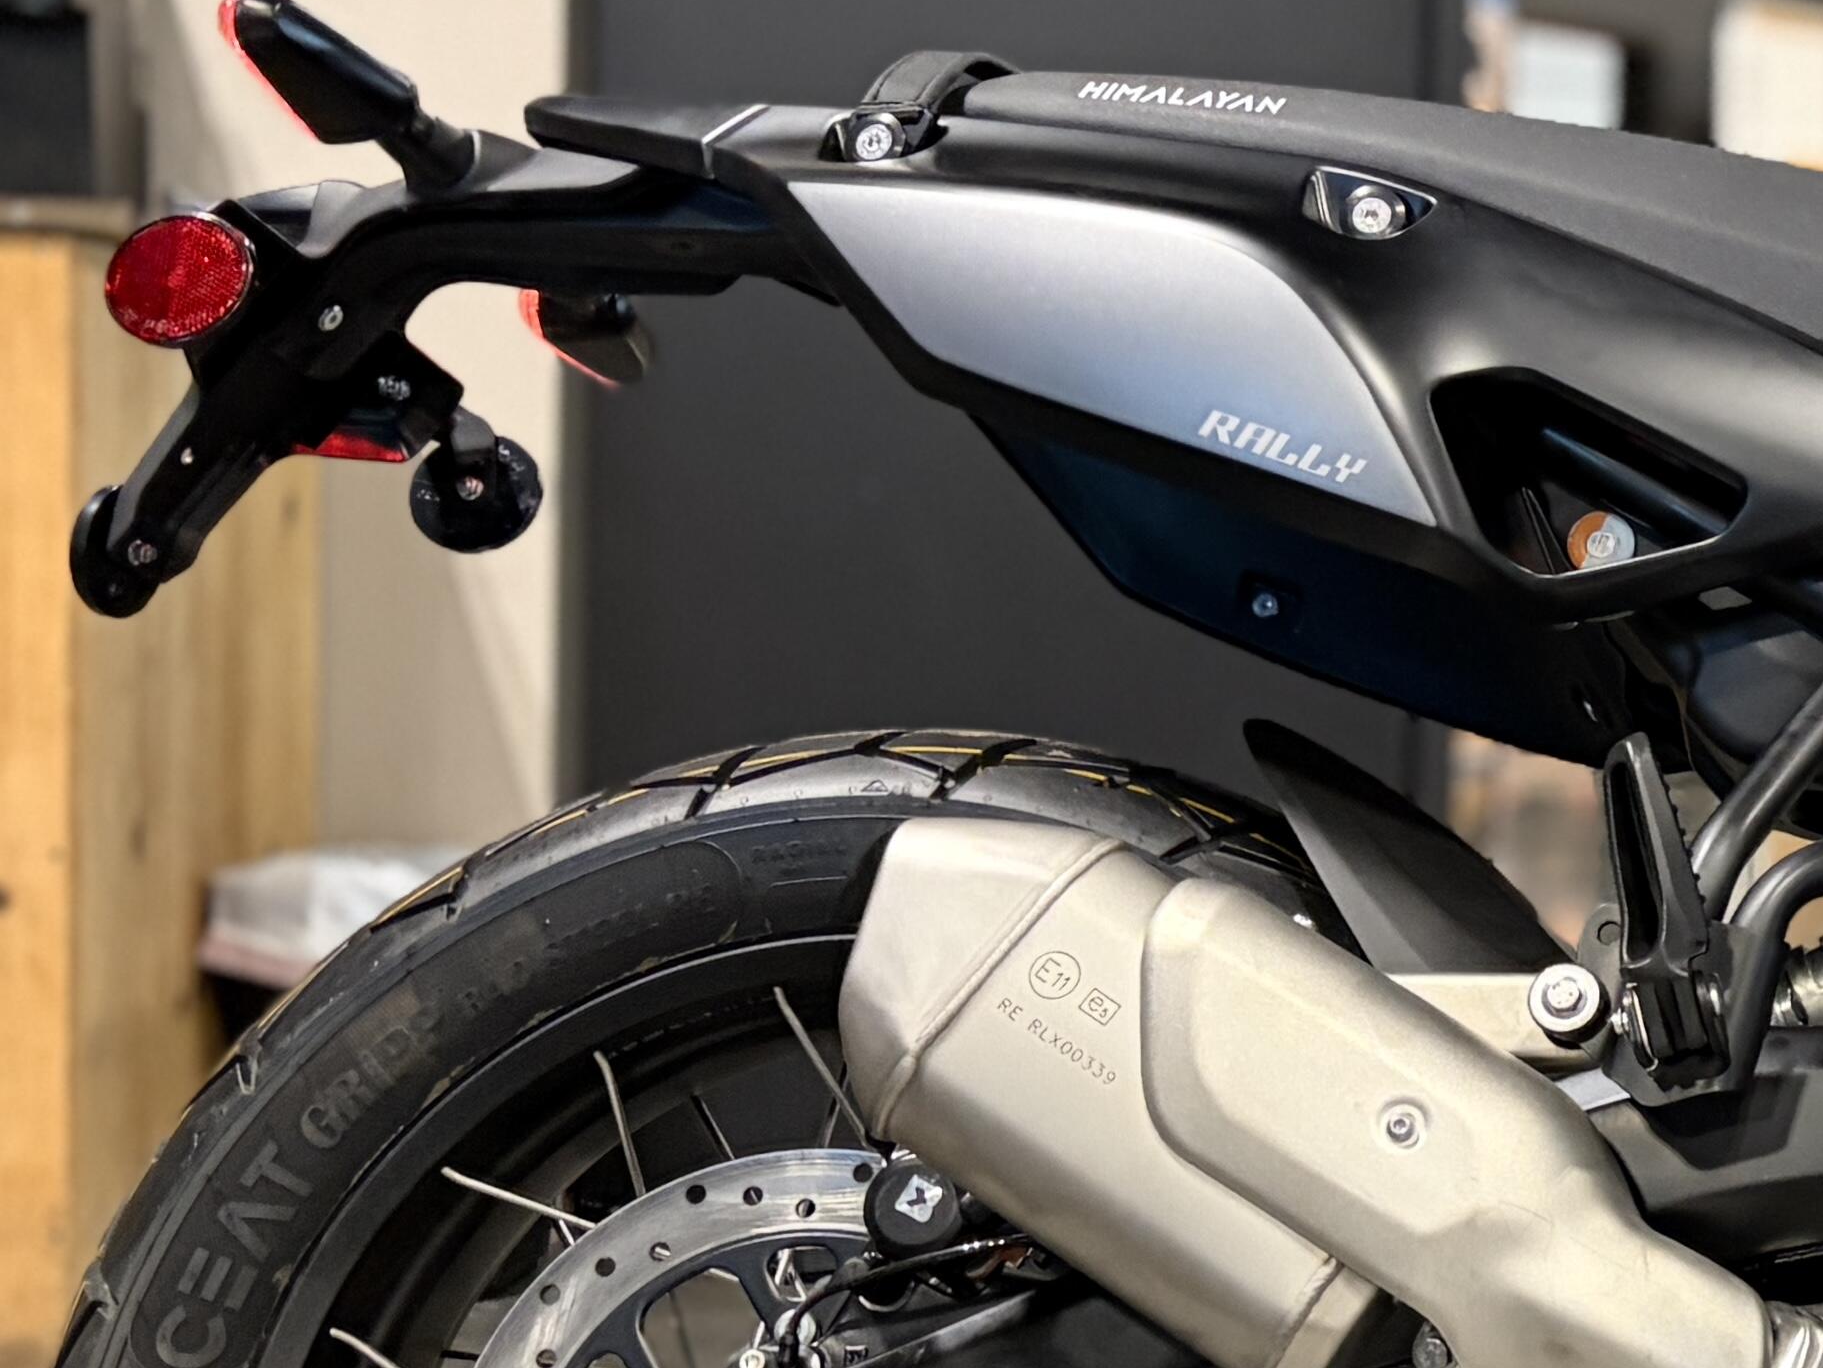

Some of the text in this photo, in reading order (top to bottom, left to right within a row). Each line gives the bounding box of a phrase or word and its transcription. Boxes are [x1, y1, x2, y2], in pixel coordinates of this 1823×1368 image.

[1077, 81, 1287, 115] HIMALAYAN
[1197, 409, 1368, 483] RALLY
[1034, 957, 1071, 991] E11
[996, 997, 1117, 1085] RE RLX00339
